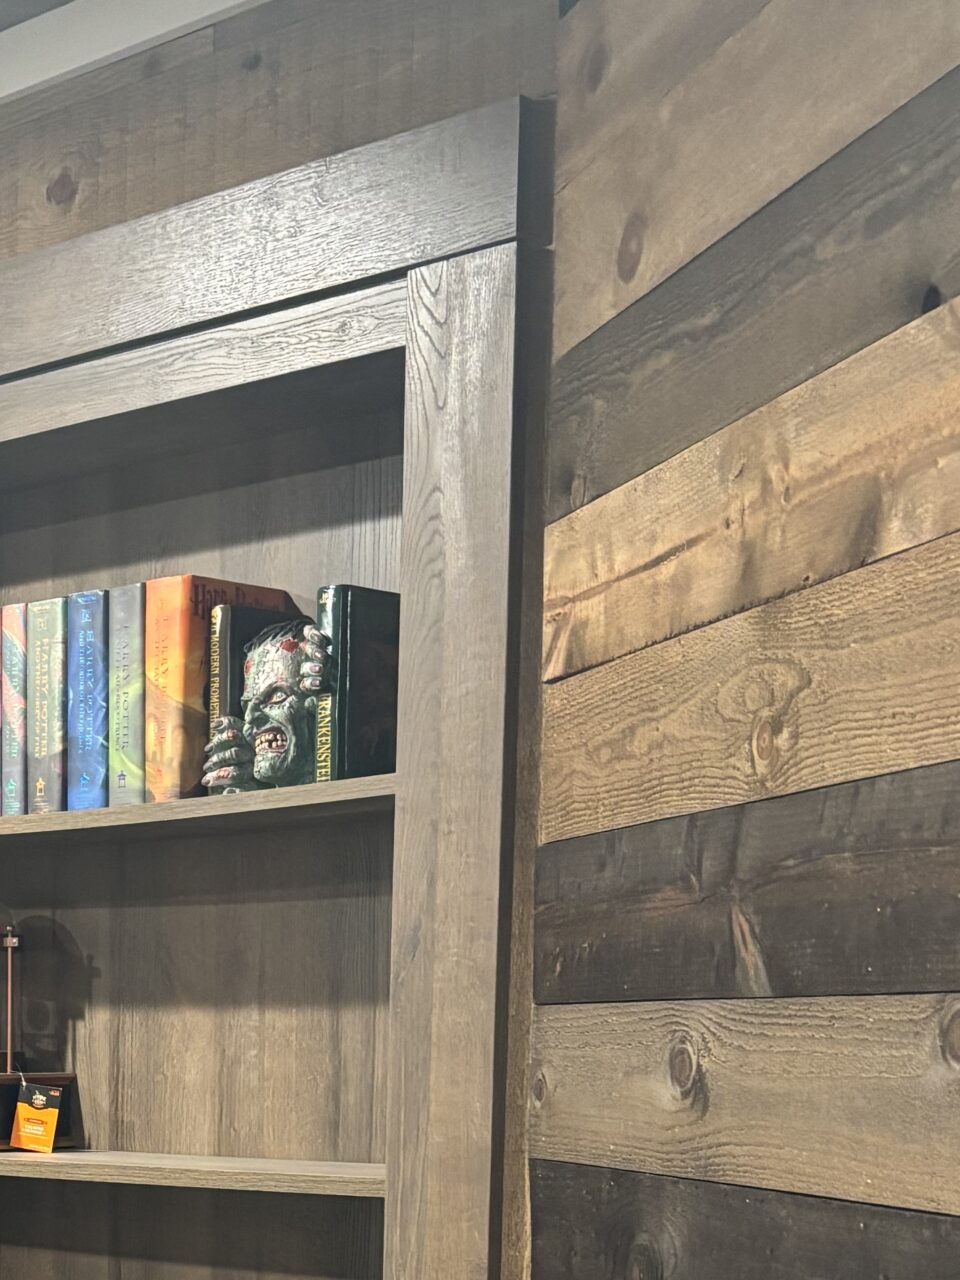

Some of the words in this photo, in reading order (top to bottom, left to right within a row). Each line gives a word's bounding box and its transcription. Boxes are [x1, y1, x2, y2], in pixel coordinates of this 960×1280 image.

[41, 638, 49, 696] HARRY
[86, 630, 94, 689] HARRY
[40, 700, 49, 758] POTTER
[86, 694, 94, 751] POTTER
[121, 692, 129, 750] POTTER
